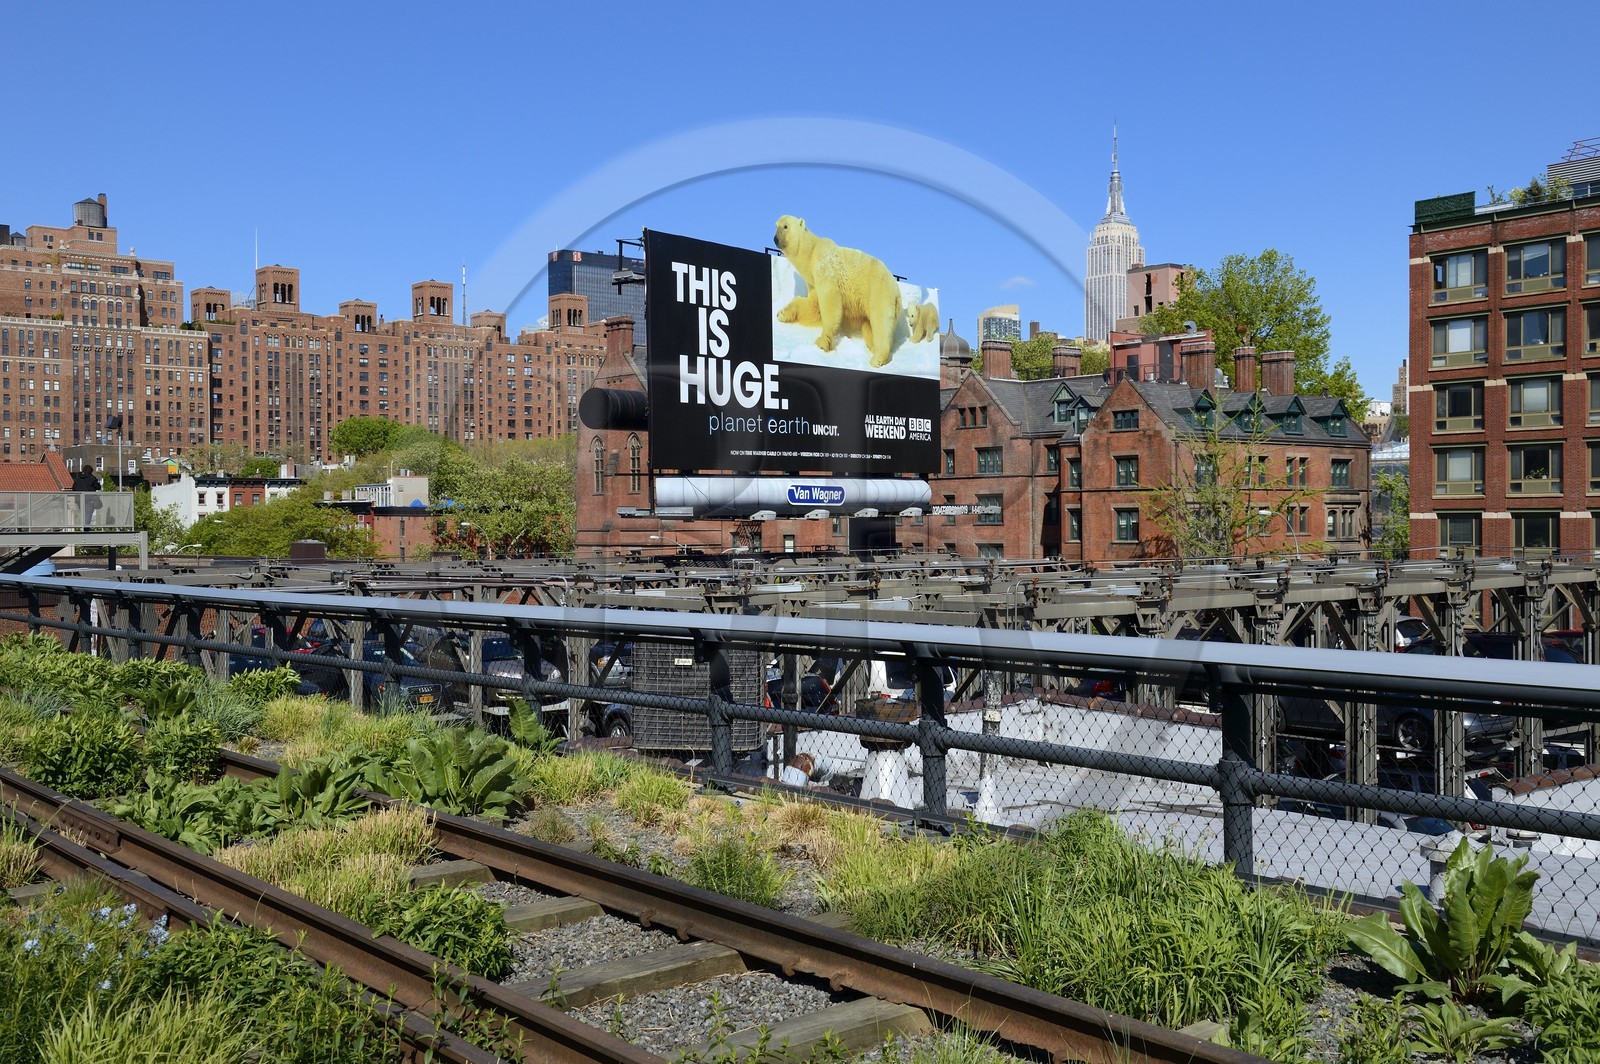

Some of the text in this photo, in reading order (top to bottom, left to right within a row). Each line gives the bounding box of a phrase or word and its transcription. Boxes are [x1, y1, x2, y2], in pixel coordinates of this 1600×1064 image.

[671, 261, 737, 311] THIS
[698, 307, 730, 358] IS
[679, 354, 789, 410] HUGE.
[708, 411, 840, 437] planet earth UNCUT.
[864, 414, 907, 426] ALL EARTH DAY
[908, 417, 932, 432] BBC
[864, 424, 907, 440] WEEKEND
[908, 432, 932, 442] AMERICA
[793, 486, 843, 503] Van Wagner
